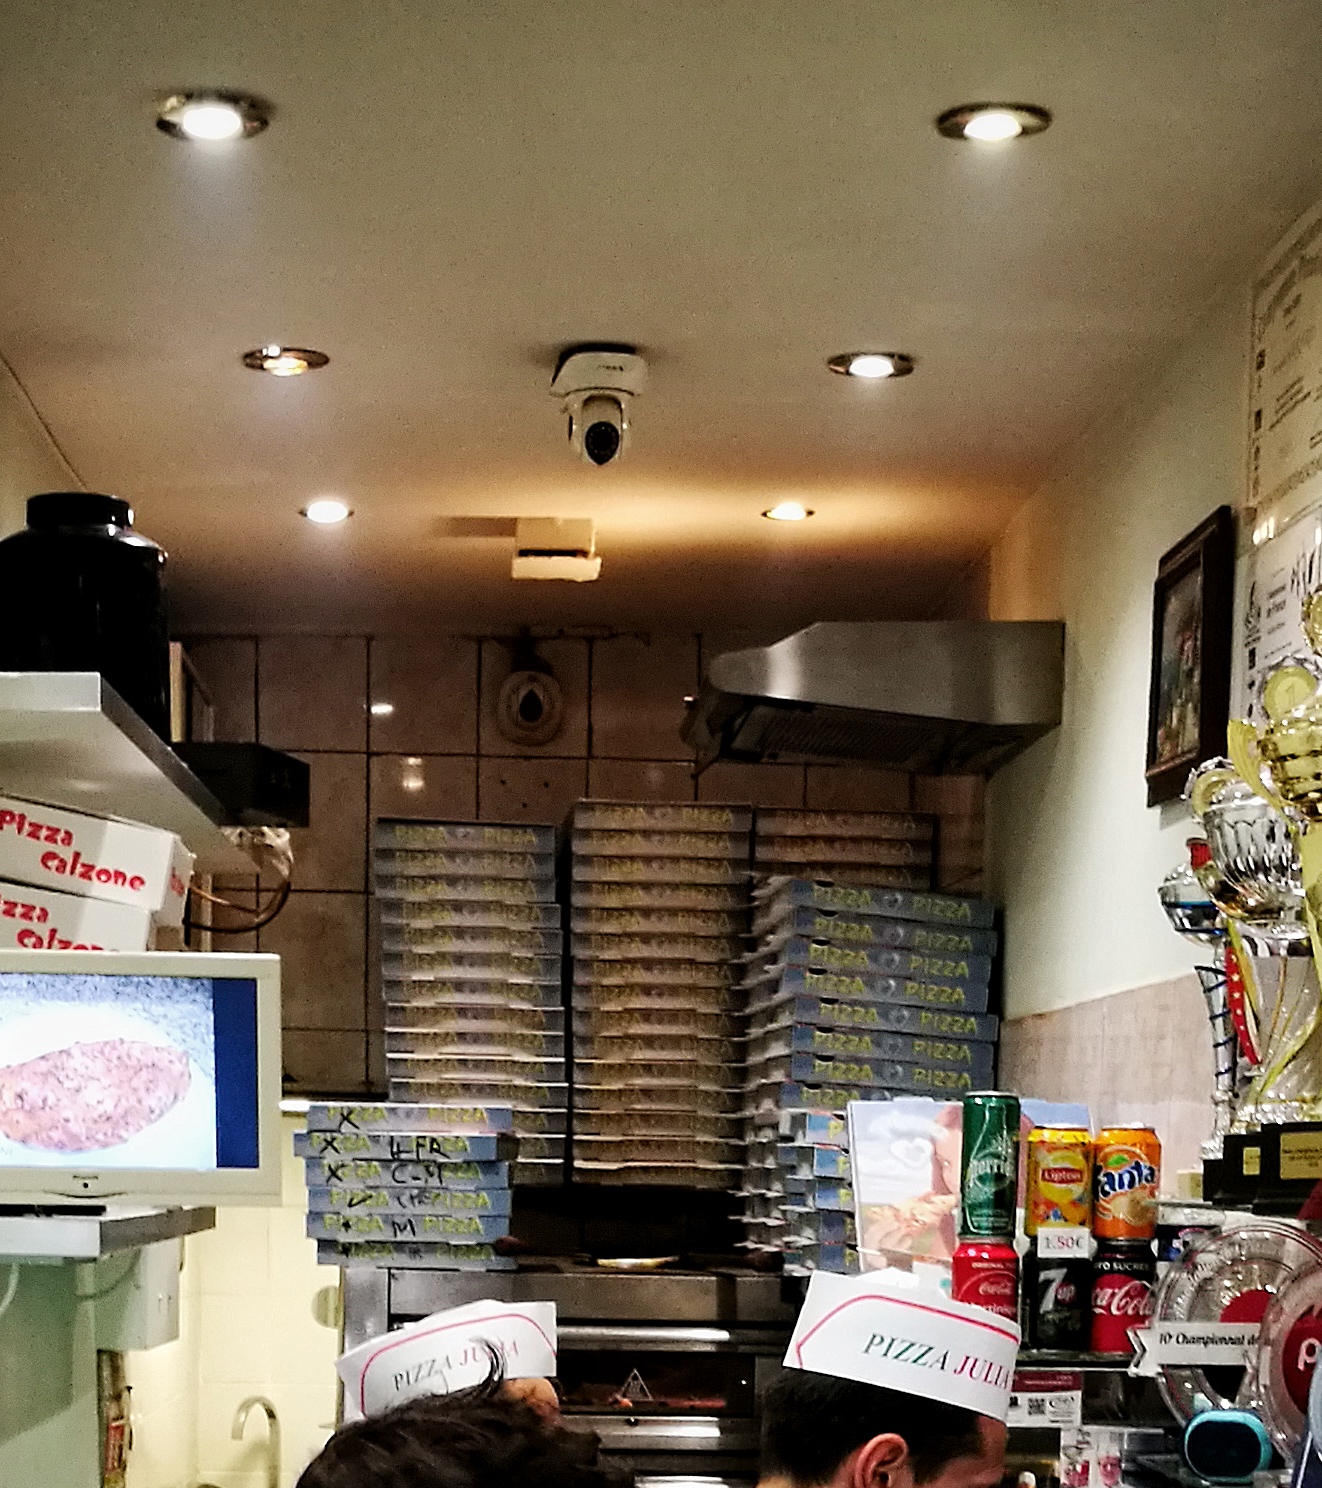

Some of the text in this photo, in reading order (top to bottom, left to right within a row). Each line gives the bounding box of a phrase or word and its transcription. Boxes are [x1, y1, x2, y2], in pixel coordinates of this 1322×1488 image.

[38, 849, 147, 894] Calzone
[861, 1333, 950, 1371] PIZZA
[1175, 1331, 1245, 1348] Championnat
[392, 1354, 452, 1391] PIZZA
